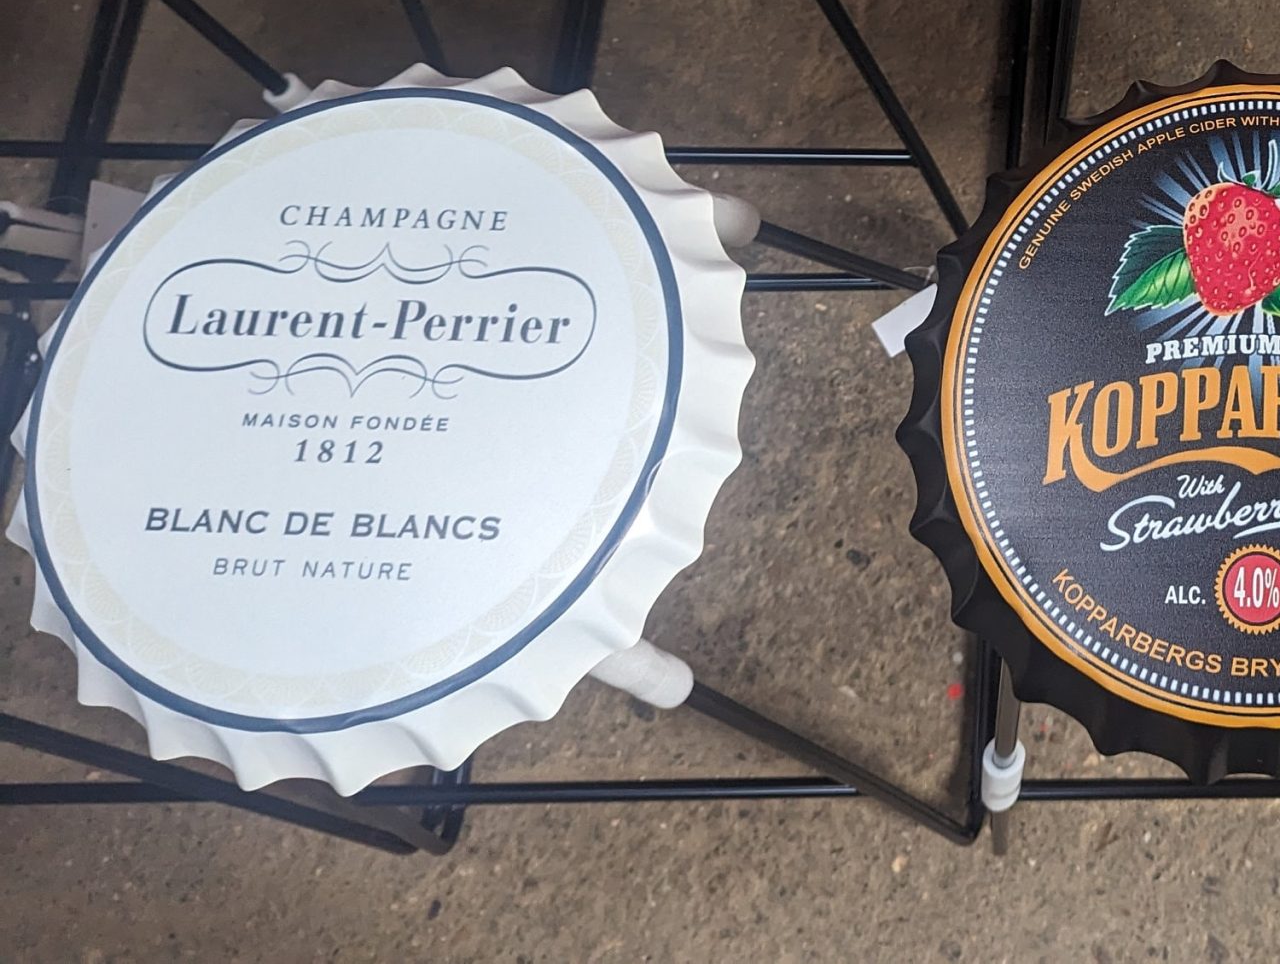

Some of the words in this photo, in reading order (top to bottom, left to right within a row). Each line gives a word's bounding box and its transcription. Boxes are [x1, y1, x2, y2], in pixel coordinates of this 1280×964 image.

[1018, 199, 1072, 271] GENUINE
[1070, 149, 1135, 202] SWEDISH
[1136, 126, 1187, 156] APPLE
[1188, 116, 1237, 135] CIDER
[1240, 115, 1280, 127] WITH
[279, 204, 509, 232] CHAMPAGNE
[165, 293, 571, 345] Laurent-Perrier
[241, 412, 339, 430] MAISON
[349, 414, 450, 433] FONDÉE
[293, 438, 384, 465] 1812
[1176, 473, 1226, 499] With
[144, 507, 271, 534] BLANC
[283, 511, 335, 537] DE
[349, 513, 503, 542] BLANCS
[212, 557, 286, 577] BRUT
[301, 559, 413, 582] NATURE
[1163, 584, 1207, 606] ALC.
[1233, 565, 1280, 610] 4.0%
[1051, 567, 1223, 674] KOPPARBERGS
